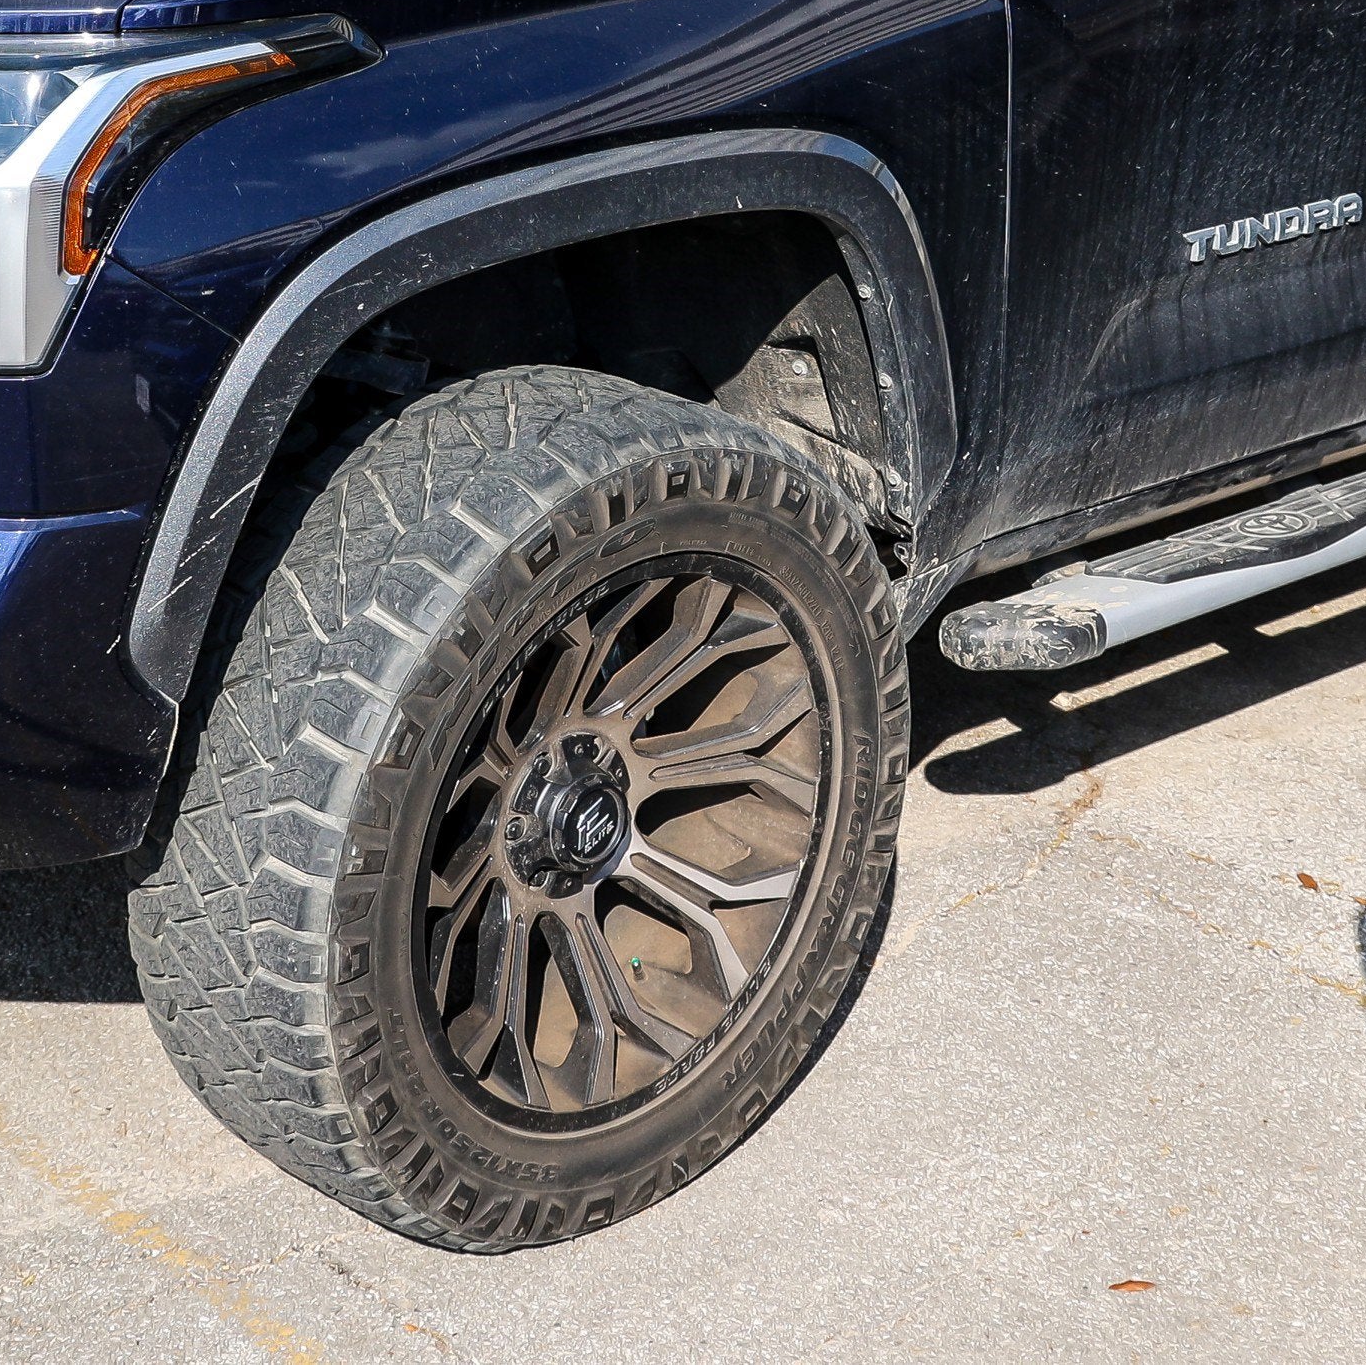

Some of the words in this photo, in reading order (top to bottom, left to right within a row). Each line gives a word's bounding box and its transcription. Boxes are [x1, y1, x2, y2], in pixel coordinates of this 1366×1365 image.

[1182, 192, 1364, 263] TUNDRA
[840, 733, 875, 867] RIDGE
[720, 875, 854, 1092] GRAPPLER
